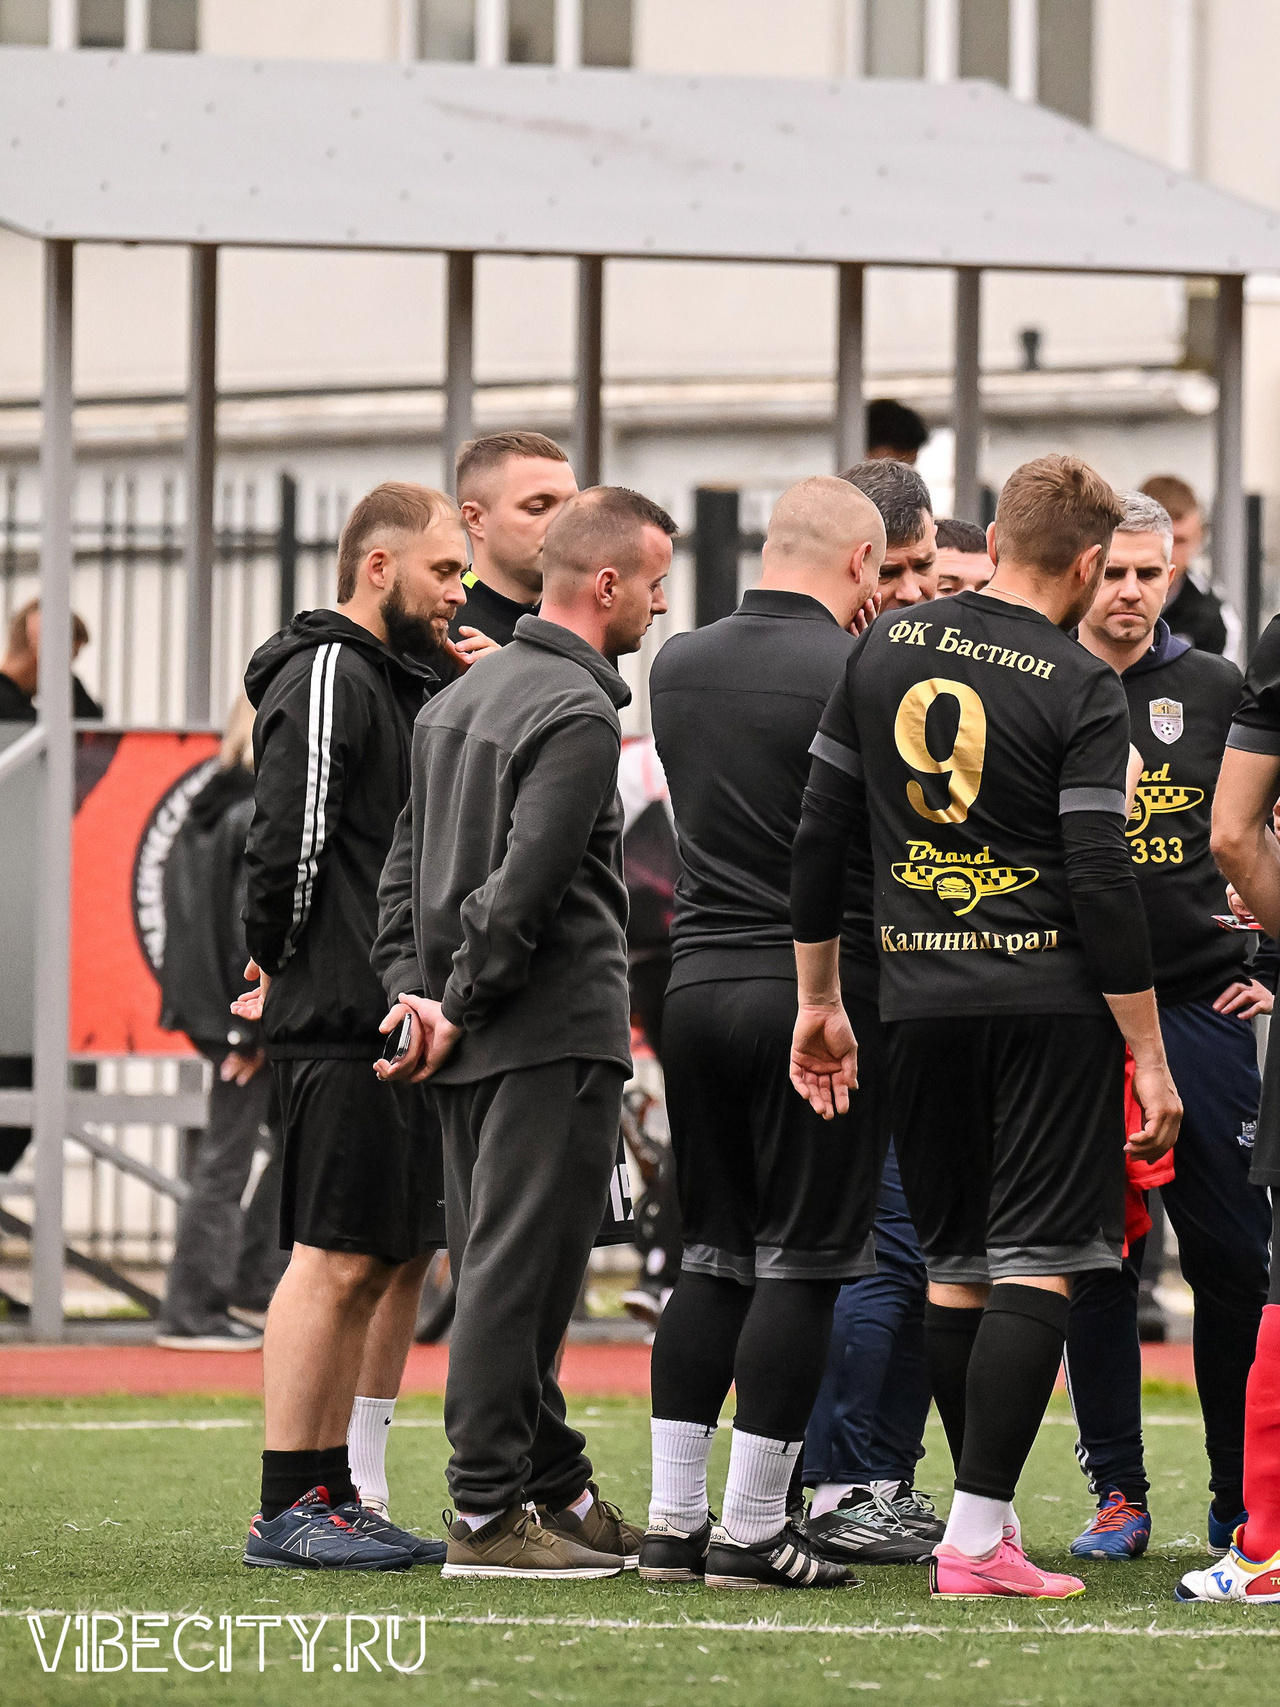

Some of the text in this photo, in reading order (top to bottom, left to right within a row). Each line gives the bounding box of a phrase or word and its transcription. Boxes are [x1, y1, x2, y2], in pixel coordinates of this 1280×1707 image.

[888, 619, 1056, 681] ФК Бастион
[894, 677, 987, 824] 9
[906, 840, 995, 865] Brand
[1130, 836, 1184, 864] 333
[880, 925, 1058, 956] Калининград
